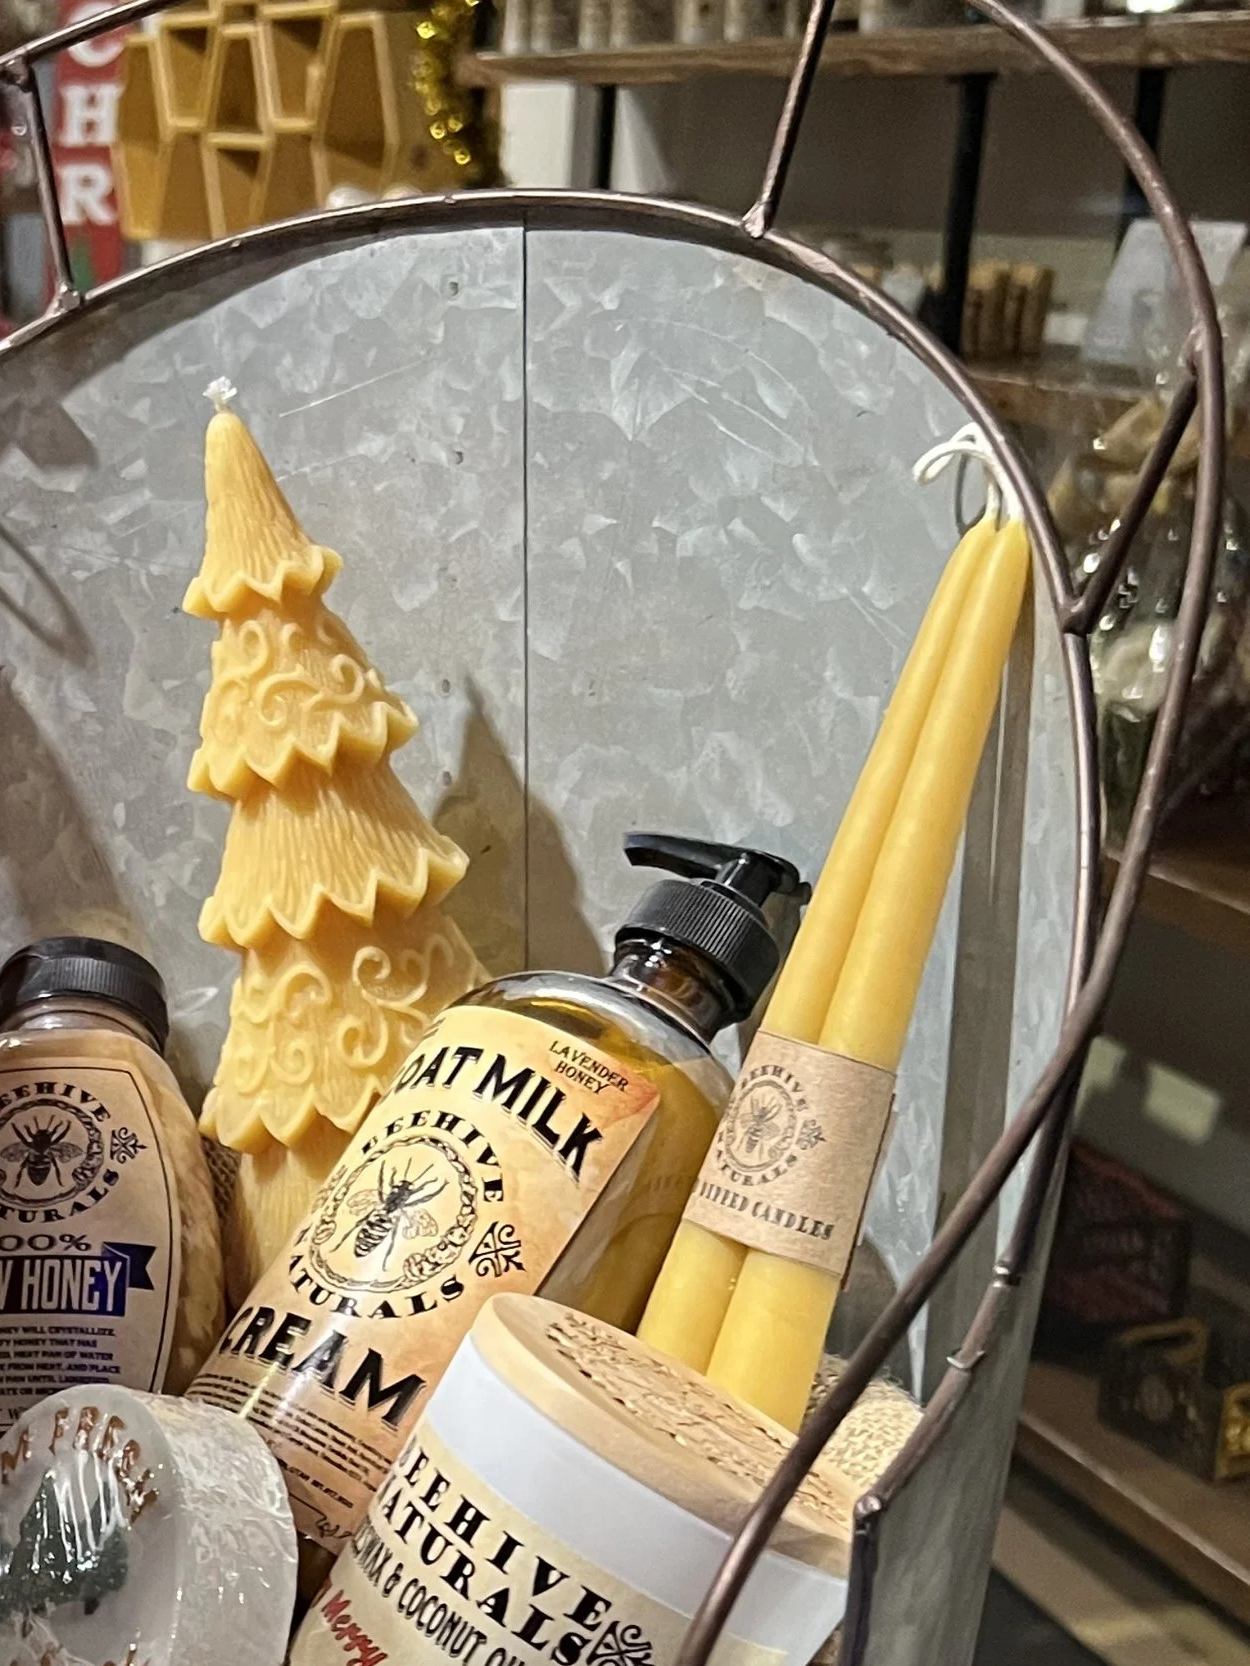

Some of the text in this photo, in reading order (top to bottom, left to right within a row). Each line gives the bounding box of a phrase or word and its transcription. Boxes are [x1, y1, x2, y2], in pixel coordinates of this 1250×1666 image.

[549, 1039, 630, 1092] LAVENDER
[554, 1060, 611, 1096] HONEY
[741, 1064, 809, 1113] BEEHIVE
[384, 1046, 603, 1184] OAT MILK
[360, 1109, 505, 1202] BEEHIVE
[751, 1200, 835, 1241] CANDLES
[20, 1258, 122, 1313] HONEY
[288, 1222, 465, 1319] NATURALS
[219, 1306, 427, 1432] CREAM
[383, 1562, 404, 1598] &
[398, 1577, 488, 1666] COCONUT
